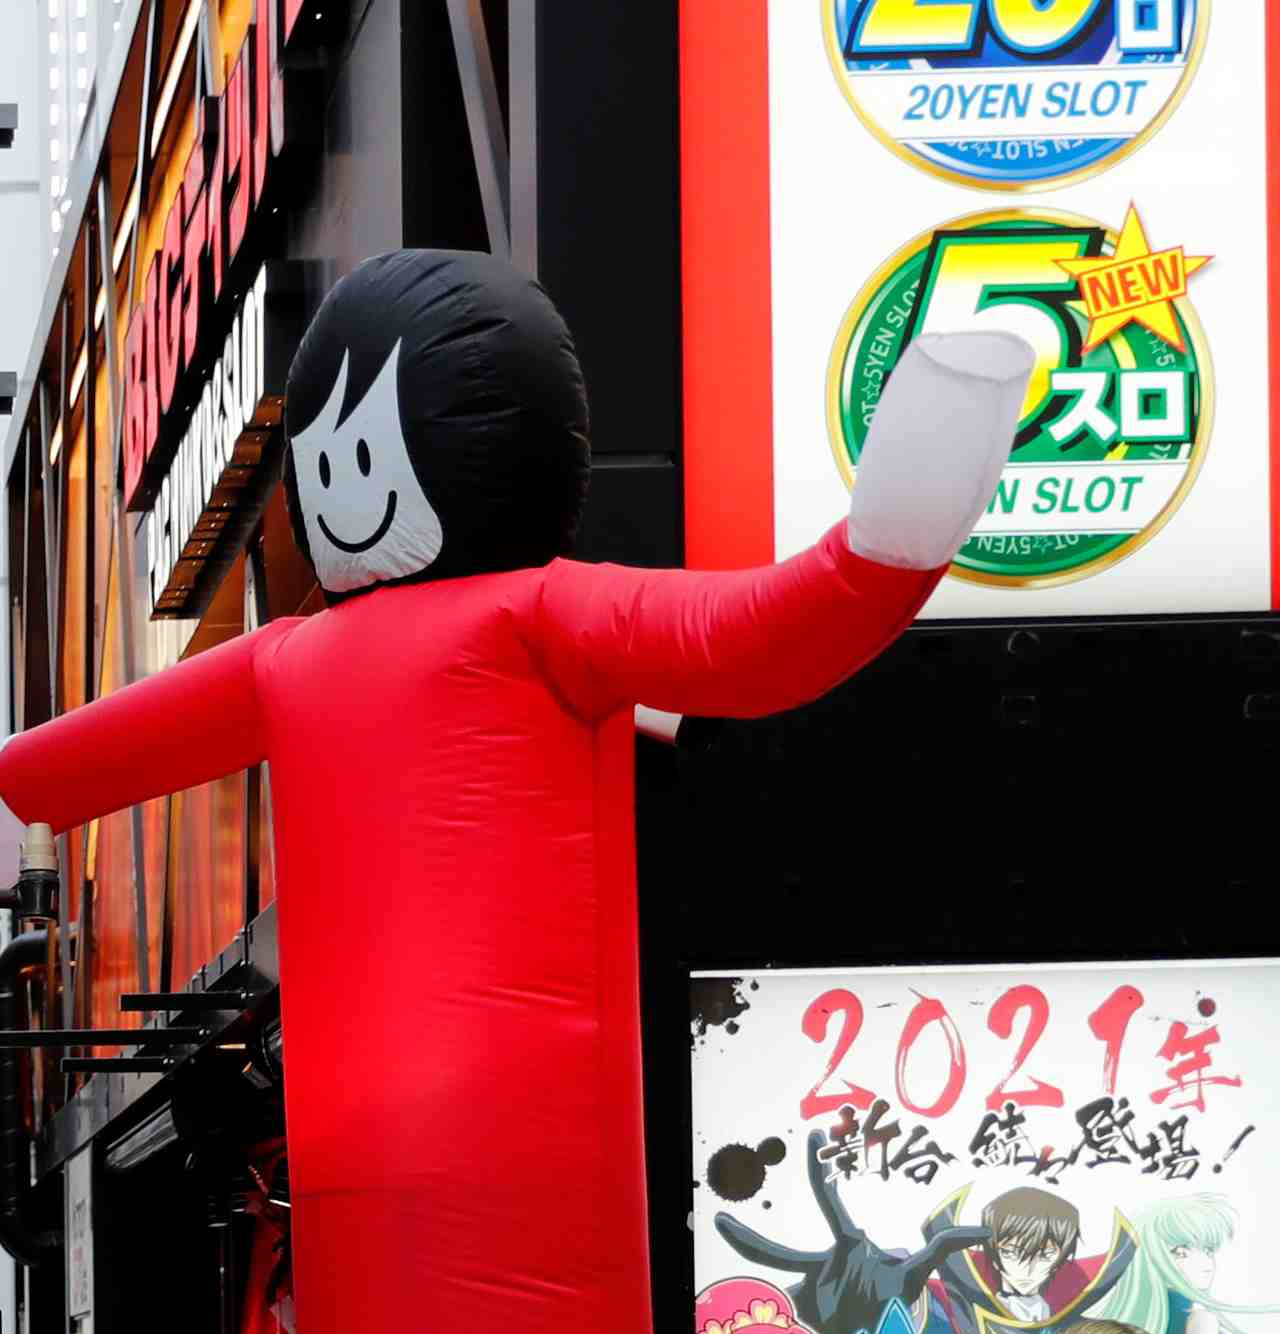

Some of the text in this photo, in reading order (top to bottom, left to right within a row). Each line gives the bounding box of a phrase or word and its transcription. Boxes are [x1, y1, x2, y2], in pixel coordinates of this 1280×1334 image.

[903, 80, 1146, 121] 20YEN SLOT
[1087, 255, 1182, 311] NEW
[1031, 476, 1144, 513] SLOT
[800, 983, 1243, 1121] 2021年
